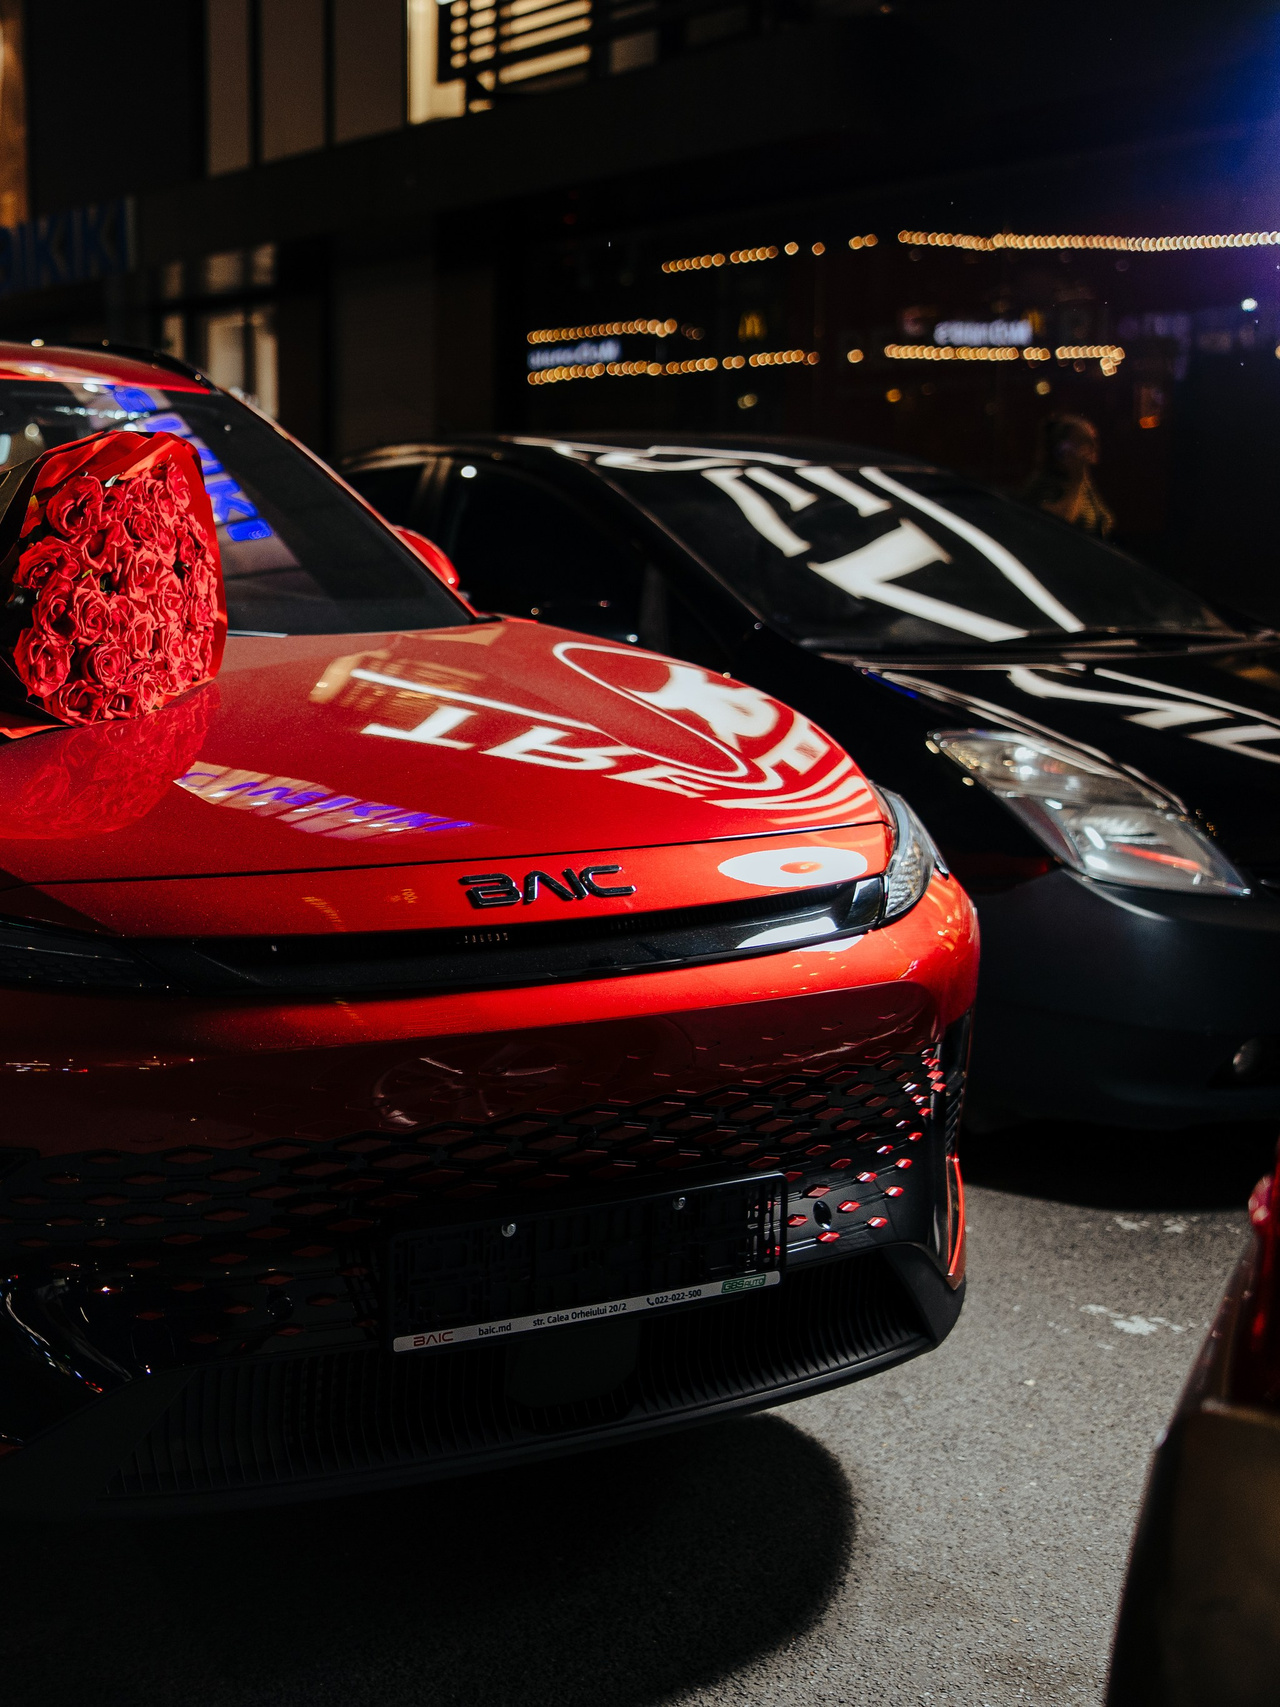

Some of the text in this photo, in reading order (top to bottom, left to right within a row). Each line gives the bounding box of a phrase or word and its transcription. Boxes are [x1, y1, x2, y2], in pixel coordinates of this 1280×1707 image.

[458, 863, 637, 909] BAIC
[413, 1331, 454, 1347] BAIC
[478, 1323, 512, 1336] baic.md
[532, 1318, 545, 1327] str.
[547, 1314, 569, 1324] Calea
[571, 1305, 607, 1320] Orheiului
[608, 1303, 627, 1313] 20/2
[654, 1289, 702, 1305] 022-022-500
